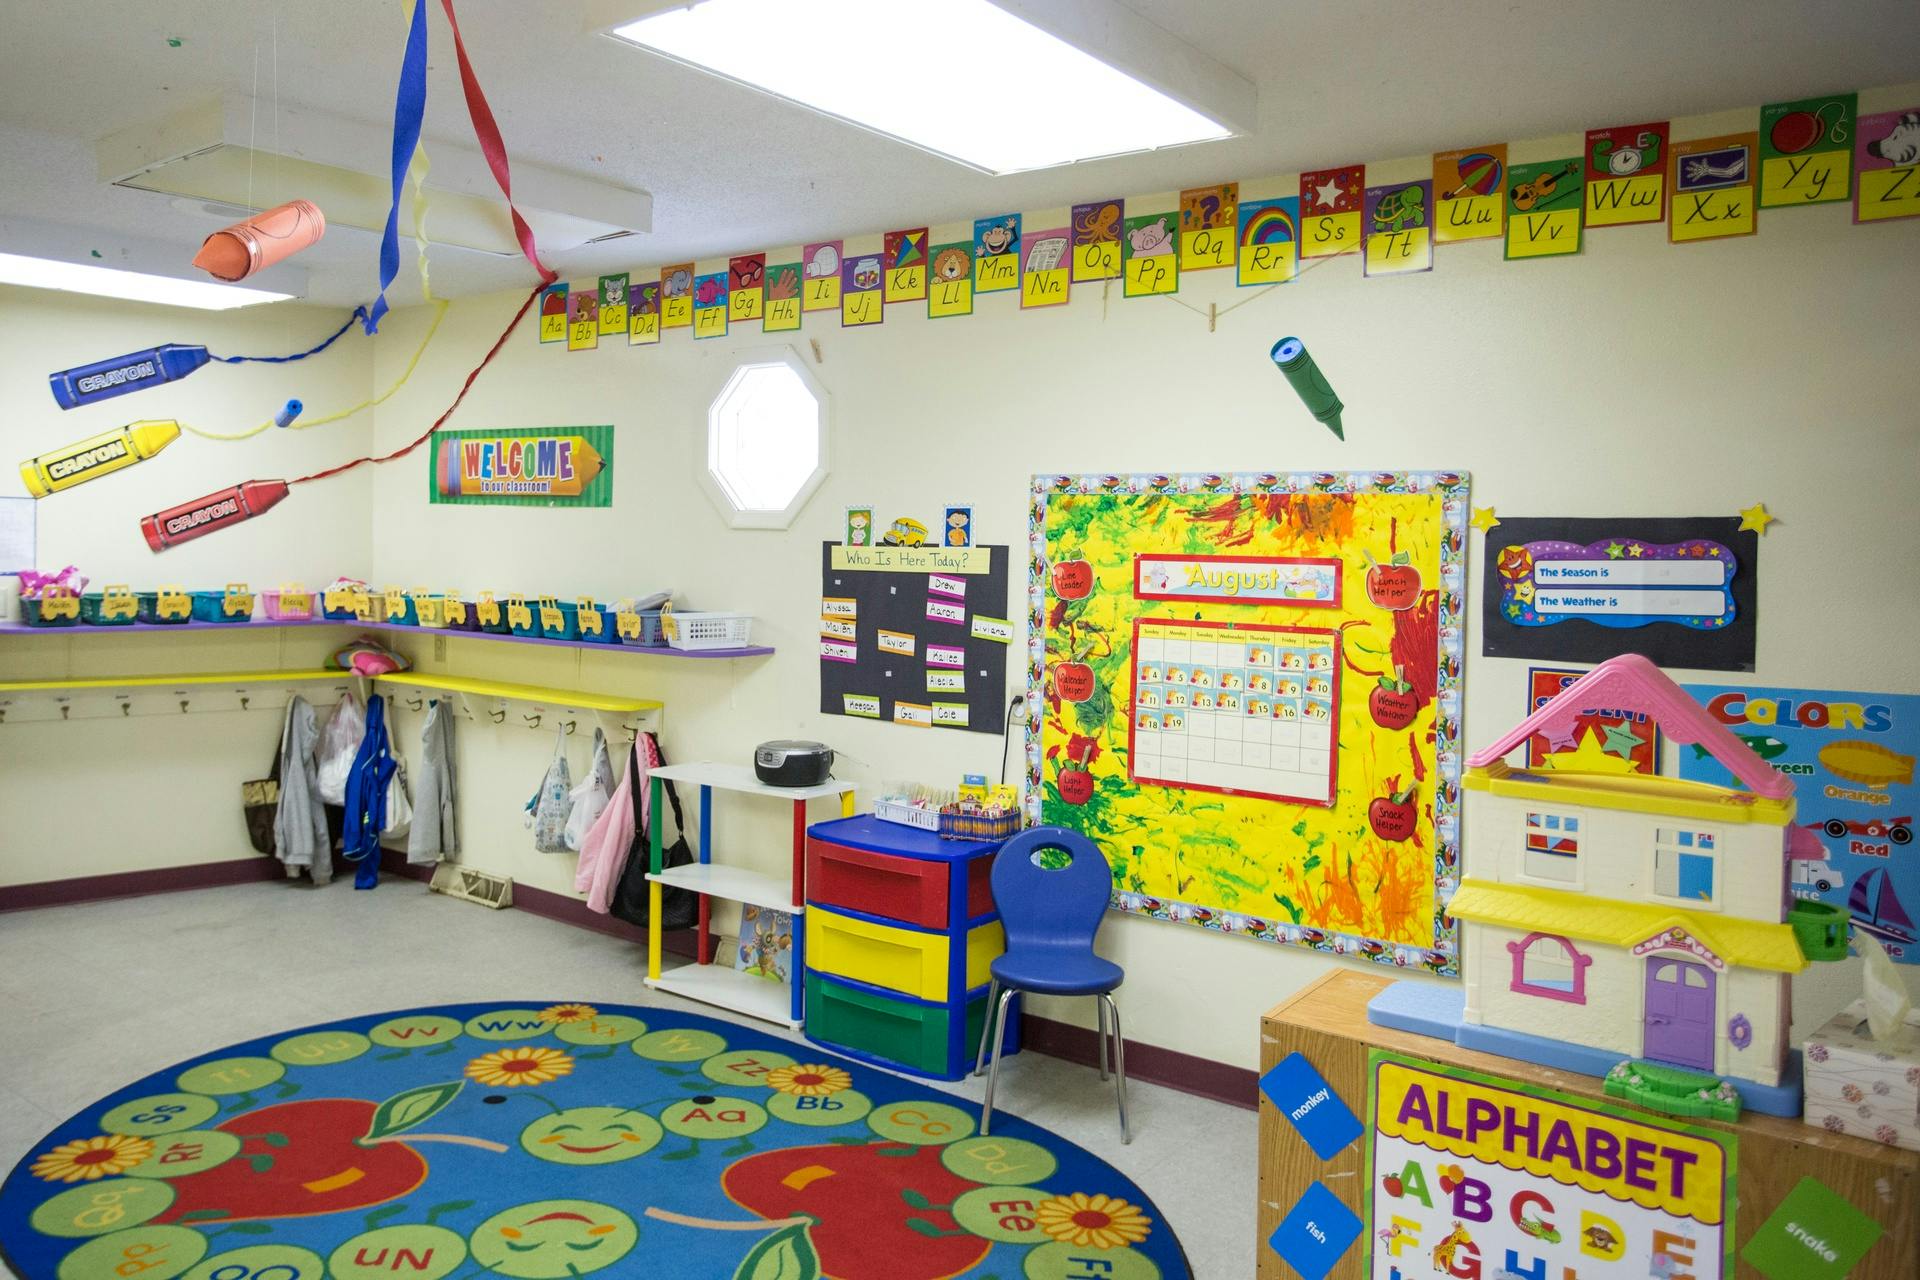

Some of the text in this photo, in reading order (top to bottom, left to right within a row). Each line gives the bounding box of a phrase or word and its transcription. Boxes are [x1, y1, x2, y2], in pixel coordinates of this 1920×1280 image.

[1782, 156, 1830, 200] Yy
[1880, 168, 1920, 201] Z
[1593, 179, 1658, 210] Ww
[1450, 200, 1492, 226] Uu
[1685, 193, 1741, 224] Xx
[1314, 217, 1345, 242] Ss
[1528, 213, 1564, 242] Vv
[1193, 231, 1223, 264] Qq
[1385, 231, 1412, 259] Tt
[1085, 245, 1111, 268] Oo
[1250, 246, 1283, 271] Rr
[892, 269, 918, 291] Kk
[979, 258, 1016, 280] Mm
[1138, 258, 1166, 292] Pp
[814, 280, 830, 300] Ii
[942, 282, 961, 304] Ll
[1030, 272, 1060, 295] Nn
[667, 299, 685, 317] Ee
[734, 291, 755, 318] Gg
[772, 301, 794, 320] Hh
[850, 293, 871, 322] Jj
[546, 317, 562, 333] Aa
[605, 308, 621, 325] Cc
[634, 317, 655, 335] Dd
[700, 308, 720, 328] Ff
[575, 324, 591, 340] Bb
[79, 361, 155, 393] CRAYON
[48, 440, 128, 479] CRAYON
[465, 440, 573, 480] WELCOME
[481, 481, 552, 492] to our classroom!
[166, 499, 238, 533] CRAYON
[846, 551, 969, 572] Who Is Here Today?
[1540, 567, 1609, 578] The Season is
[935, 579, 955, 590] Drew
[1059, 581, 1082, 590] Leader
[1186, 563, 1279, 596] August
[1373, 586, 1404, 597] Helper
[1540, 597, 1618, 607] The Weather is
[930, 604, 955, 618] Aaron
[881, 636, 907, 648] Taylor
[1321, 658, 1328, 666] 3
[1063, 684, 1084, 695] Helper
[1261, 682, 1267, 690] 8
[1318, 684, 1328, 693] 10
[1176, 696, 1185, 704] 12
[1202, 699, 1211, 707] 13
[1227, 700, 1236, 708] 14
[1259, 705, 1269, 713] 15
[1284, 709, 1295, 717] 16
[1316, 710, 1326, 718] 17
[1377, 694, 1408, 708] Weather
[938, 707, 956, 719] Cole
[1149, 719, 1182, 729] 18 19
[1063, 785, 1083, 795] Helper
[1824, 784, 1892, 805] Orange
[1378, 807, 1404, 818] Snack
[1374, 818, 1402, 831] Helper
[1850, 840, 1890, 857] Red
[389, 1026, 439, 1040] Vv
[662, 1034, 703, 1054] Yy
[726, 1058, 770, 1079] Zz
[130, 1104, 187, 1124] Ss
[681, 1107, 747, 1123] Aa
[796, 1096, 844, 1112] Bb
[1292, 1087, 1330, 1121] monkey
[888, 1109, 951, 1135] Cc
[1397, 1083, 1698, 1200] ALPHABET
[159, 1142, 204, 1164] Rr
[965, 1144, 1030, 1174] Dd
[988, 1199, 1036, 1232] Ee
[1400, 1160, 1696, 1280] A B C D E
[1305, 1221, 1326, 1244] fish
[1785, 1222, 1836, 1262] snake
[1390, 1215, 1423, 1258] F
[1440, 1231, 1481, 1280] G
[114, 1242, 172, 1278] Pp
[354, 1247, 435, 1272] Nn
